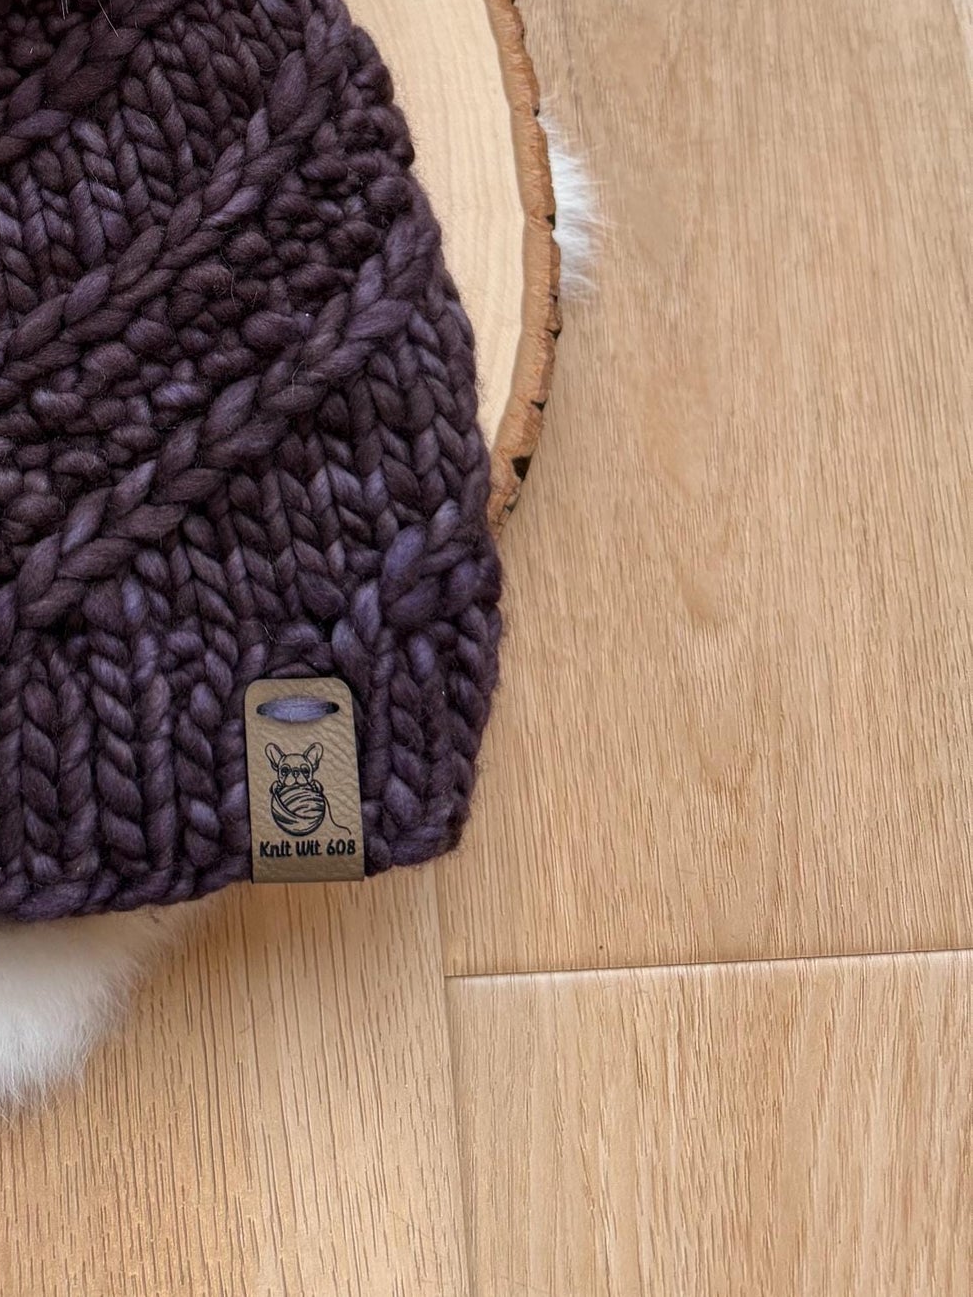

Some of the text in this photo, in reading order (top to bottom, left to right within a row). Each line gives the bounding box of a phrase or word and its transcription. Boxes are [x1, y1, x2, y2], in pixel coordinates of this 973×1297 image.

[259, 838, 356, 858] Knit Wit 608
